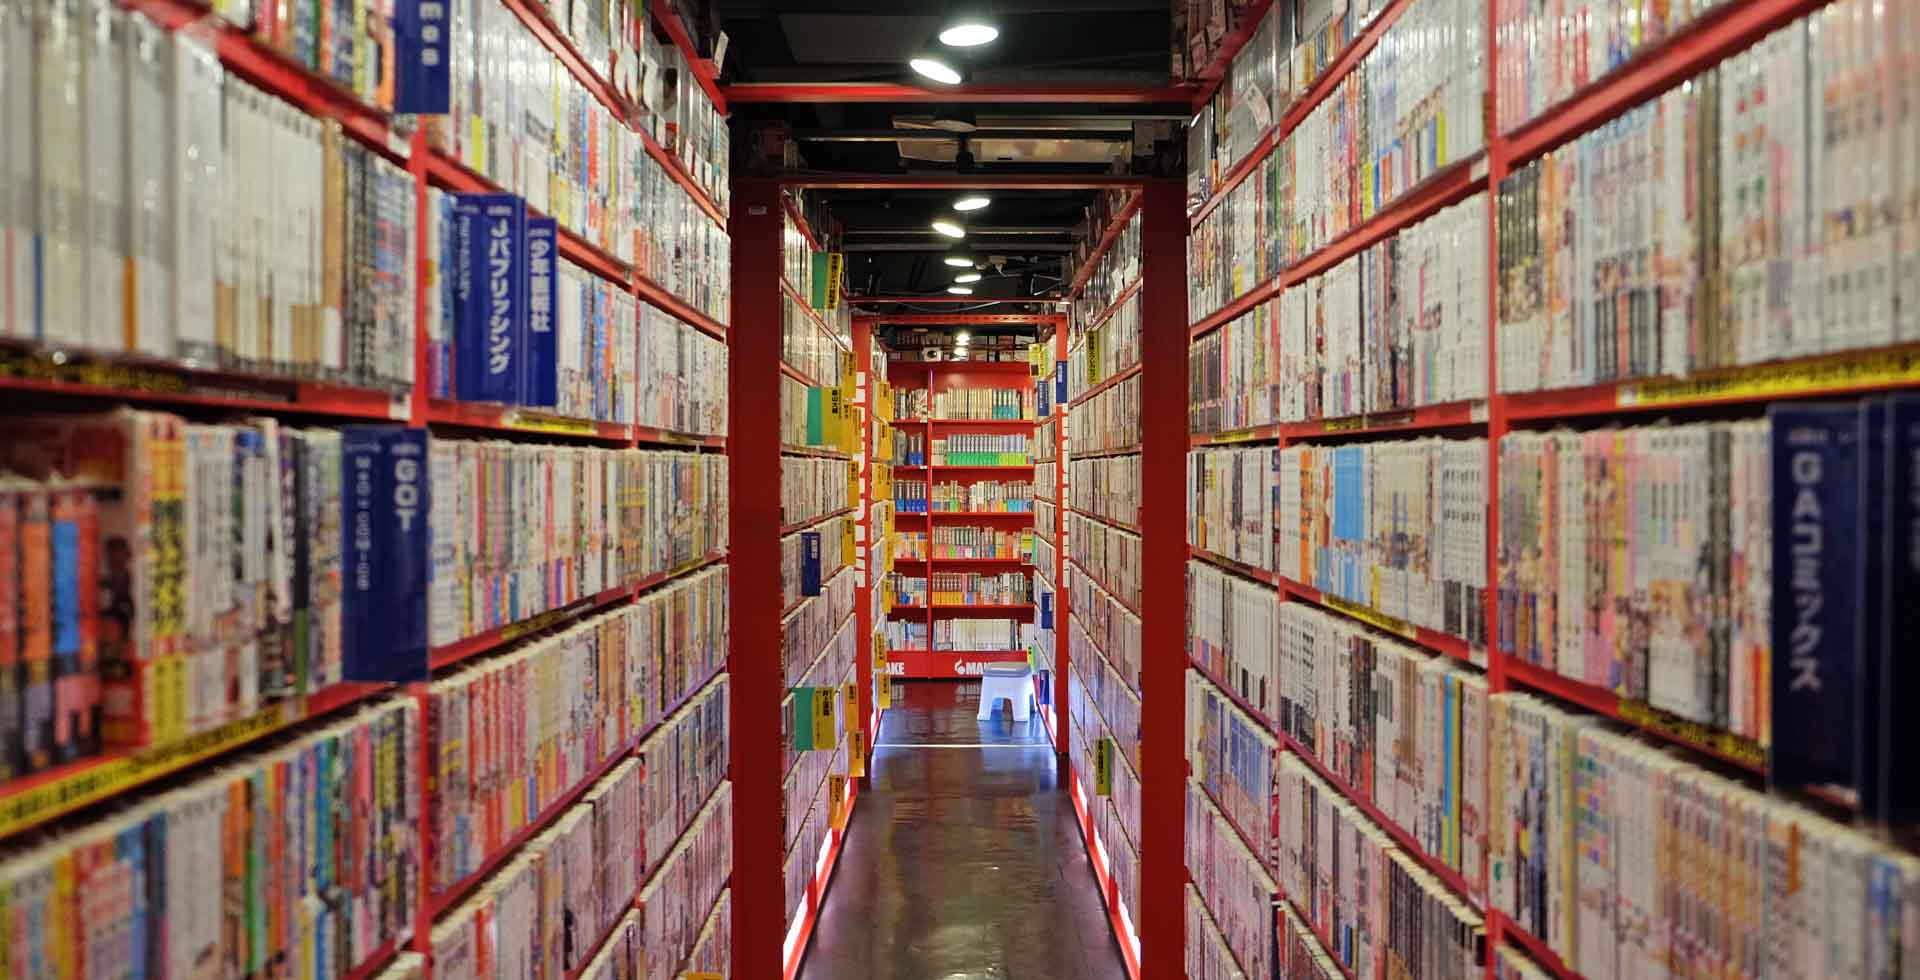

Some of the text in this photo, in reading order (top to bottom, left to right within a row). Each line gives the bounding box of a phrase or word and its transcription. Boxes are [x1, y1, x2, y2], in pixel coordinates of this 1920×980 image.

[394, 459, 418, 532] GOT
[1790, 451, 1823, 691] GAコミックス
